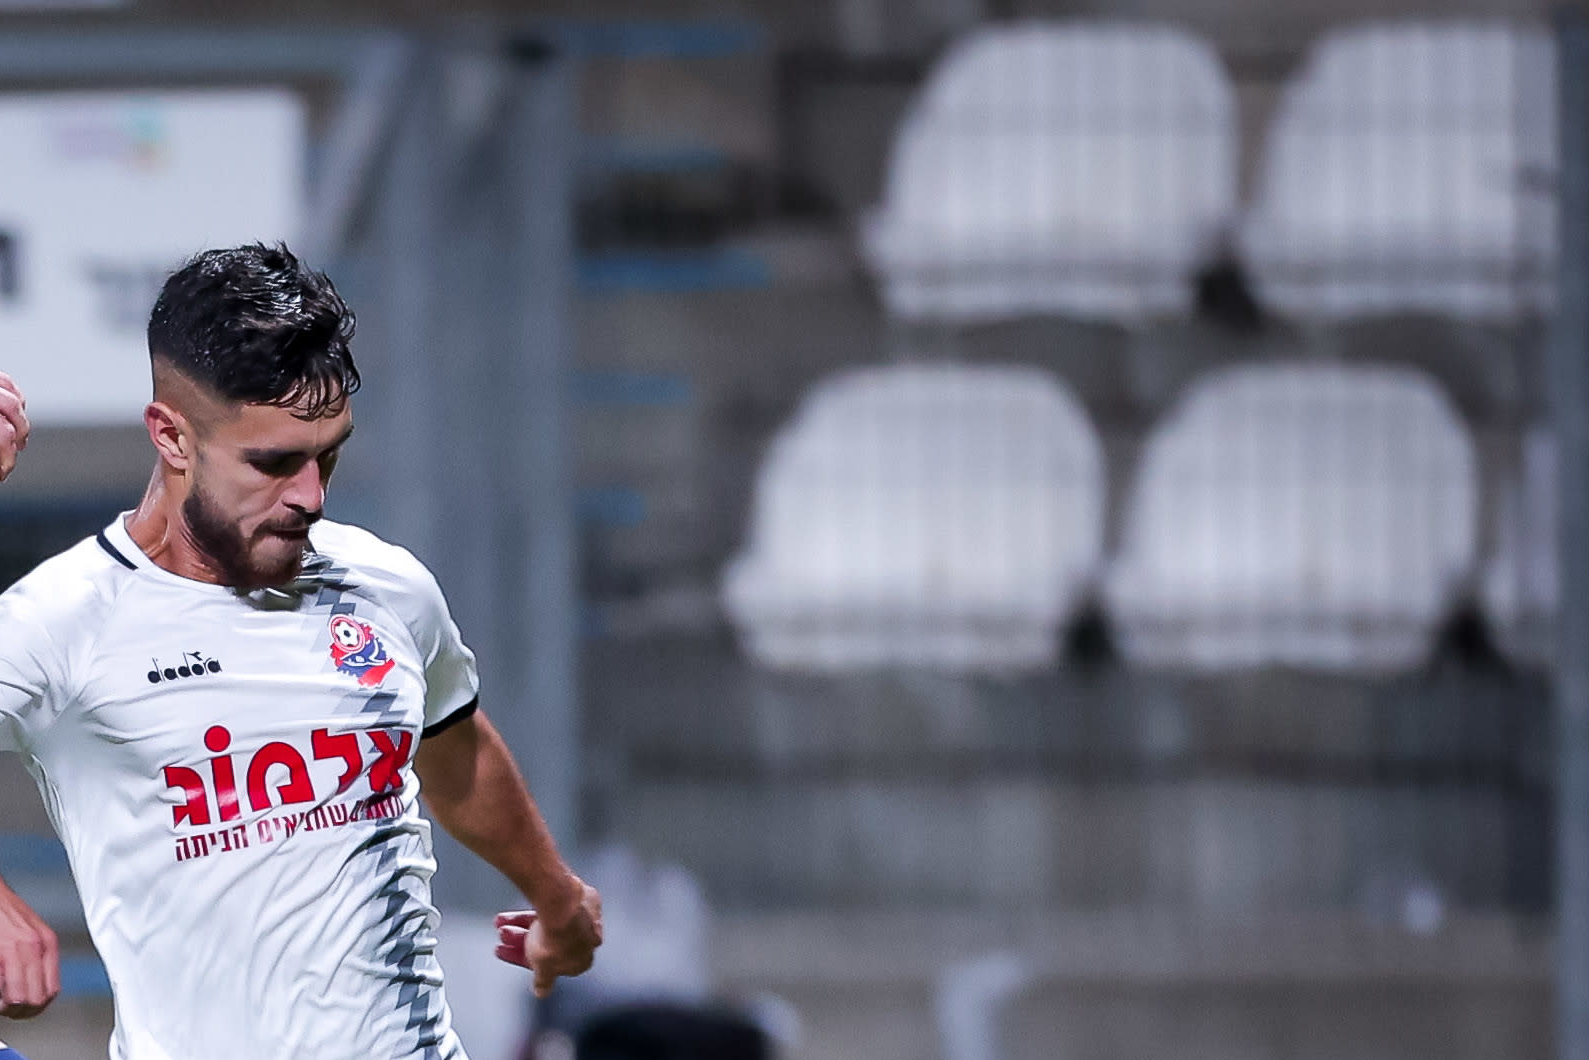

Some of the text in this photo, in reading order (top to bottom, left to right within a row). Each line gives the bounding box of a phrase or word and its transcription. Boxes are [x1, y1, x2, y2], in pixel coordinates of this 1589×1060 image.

[147, 651, 223, 684] diadora
[163, 725, 413, 829] אלמוג
[175, 824, 249, 862] הביתה
